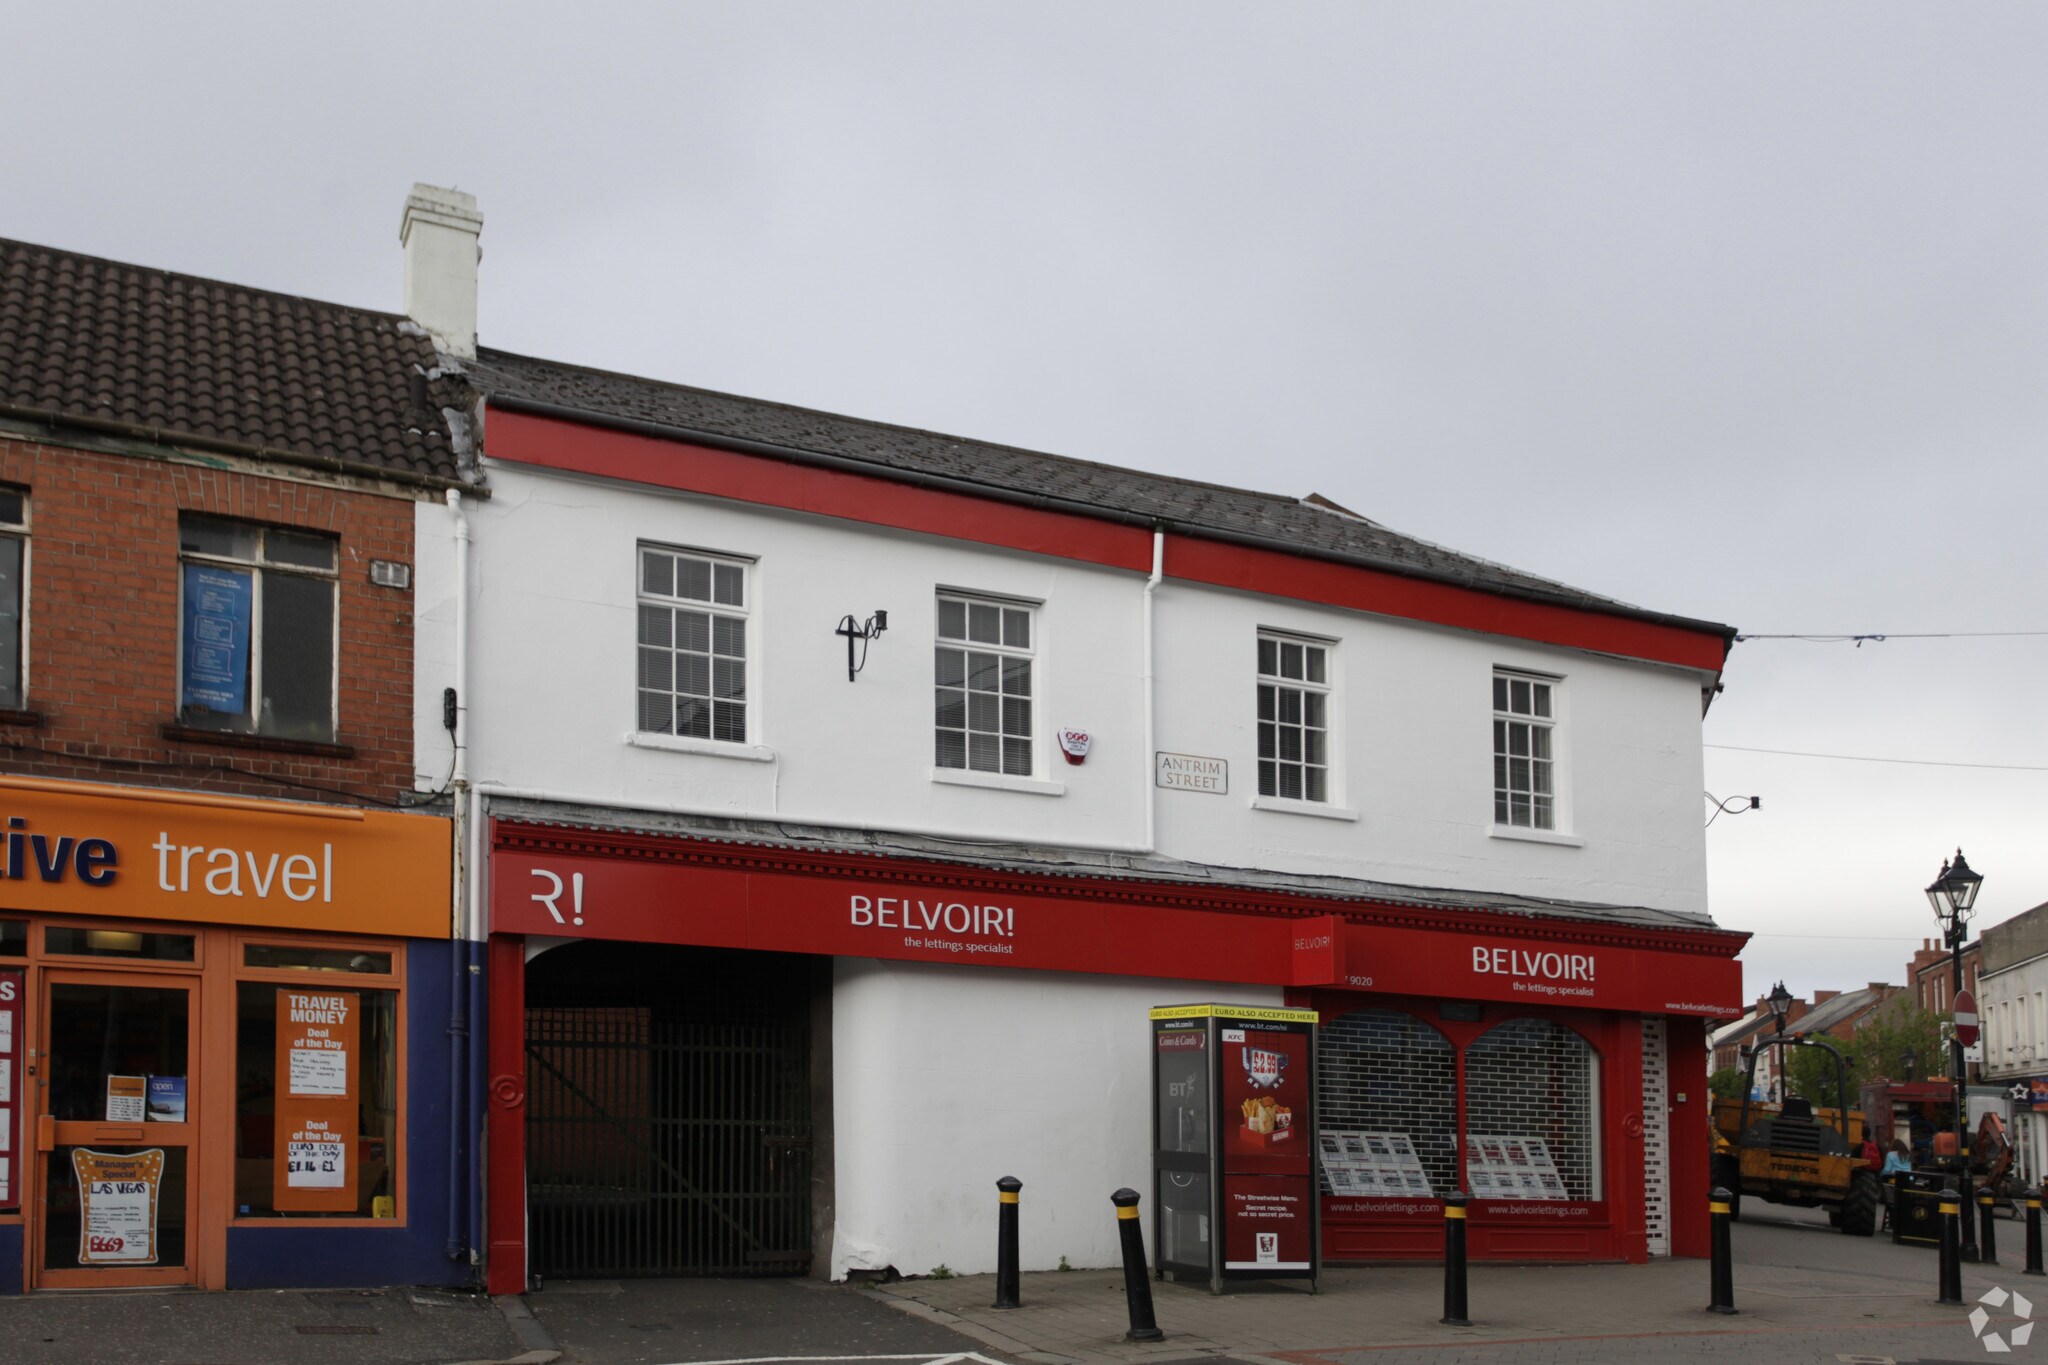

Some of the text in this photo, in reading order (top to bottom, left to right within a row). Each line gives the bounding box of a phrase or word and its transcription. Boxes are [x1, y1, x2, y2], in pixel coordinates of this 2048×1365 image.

[1162, 757, 1220, 775] ANTRIM
[1166, 772, 1218, 789] STREET
[0, 817, 332, 902] ive travel
[850, 895, 1014, 937] BELVOIR!
[904, 936, 1013, 954] the lettings specialist
[1295, 936, 1330, 950] BELVOIR!
[1472, 946, 1595, 981] BELVOIR!
[1350, 975, 1373, 986] 9020
[1513, 981, 1594, 996] the lettings specialist
[288, 995, 348, 1011] TRAVEL
[1665, 1002, 1739, 1014] www.belvoirlettings.com
[291, 1009, 347, 1024] MONEY
[1215, 1008, 1235, 1016] EURO
[1259, 1011, 1295, 1019] ACCEPTED
[1239, 1022, 1287, 1031] www.bt.com/ni
[308, 1028, 329, 1038] Deal
[294, 1038, 342, 1050] of the Day
[1160, 1035, 1196, 1046] Coins & Cards
[1253, 1051, 1276, 1074] £2.99
[152, 1082, 173, 1091] open
[1169, 1083, 1186, 1097] BT
[306, 1120, 328, 1130] Deal
[293, 1131, 341, 1142] of the Day
[290, 1143, 314, 1151] EURO
[322, 1151, 340, 1160] DAY
[95, 1160, 144, 1169] Manager's
[102, 1170, 136, 1179] Special
[91, 1182, 145, 1194] LAS VEGAS
[1330, 1202, 1439, 1215] www.belvoirlettings.com
[1488, 1204, 1588, 1217] www.belvoirlettings.com
[90, 1236, 124, 1252] £669
